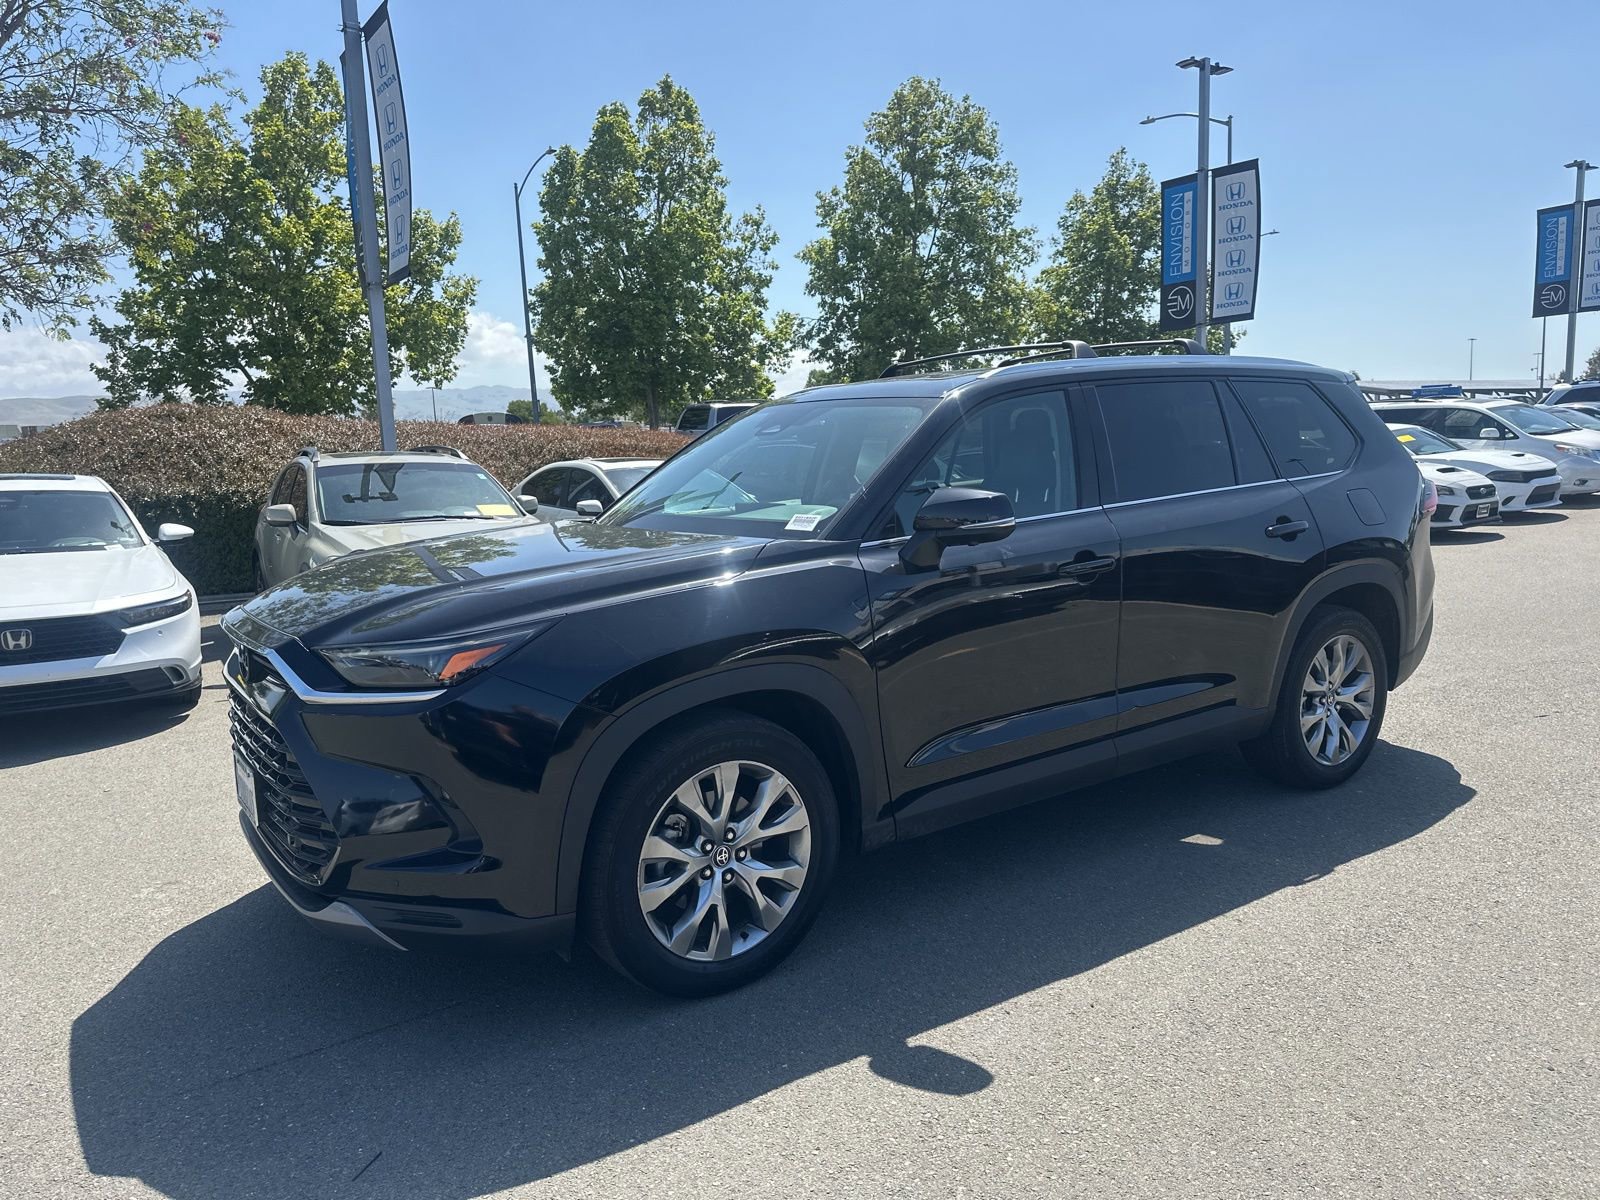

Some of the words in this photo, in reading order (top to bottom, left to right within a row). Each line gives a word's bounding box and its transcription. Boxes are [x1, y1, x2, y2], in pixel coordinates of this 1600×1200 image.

[376, 74, 397, 96] HONDA
[384, 131, 405, 153] HONDA
[388, 188, 408, 207] HONDA
[1218, 200, 1254, 211] HONDA
[1170, 193, 1183, 276] ENVISION
[1218, 234, 1254, 244] HONDA
[1544, 217, 1557, 278] ENVISION
[1217, 267, 1252, 277] HONDA
[1216, 300, 1249, 309] HONDA
